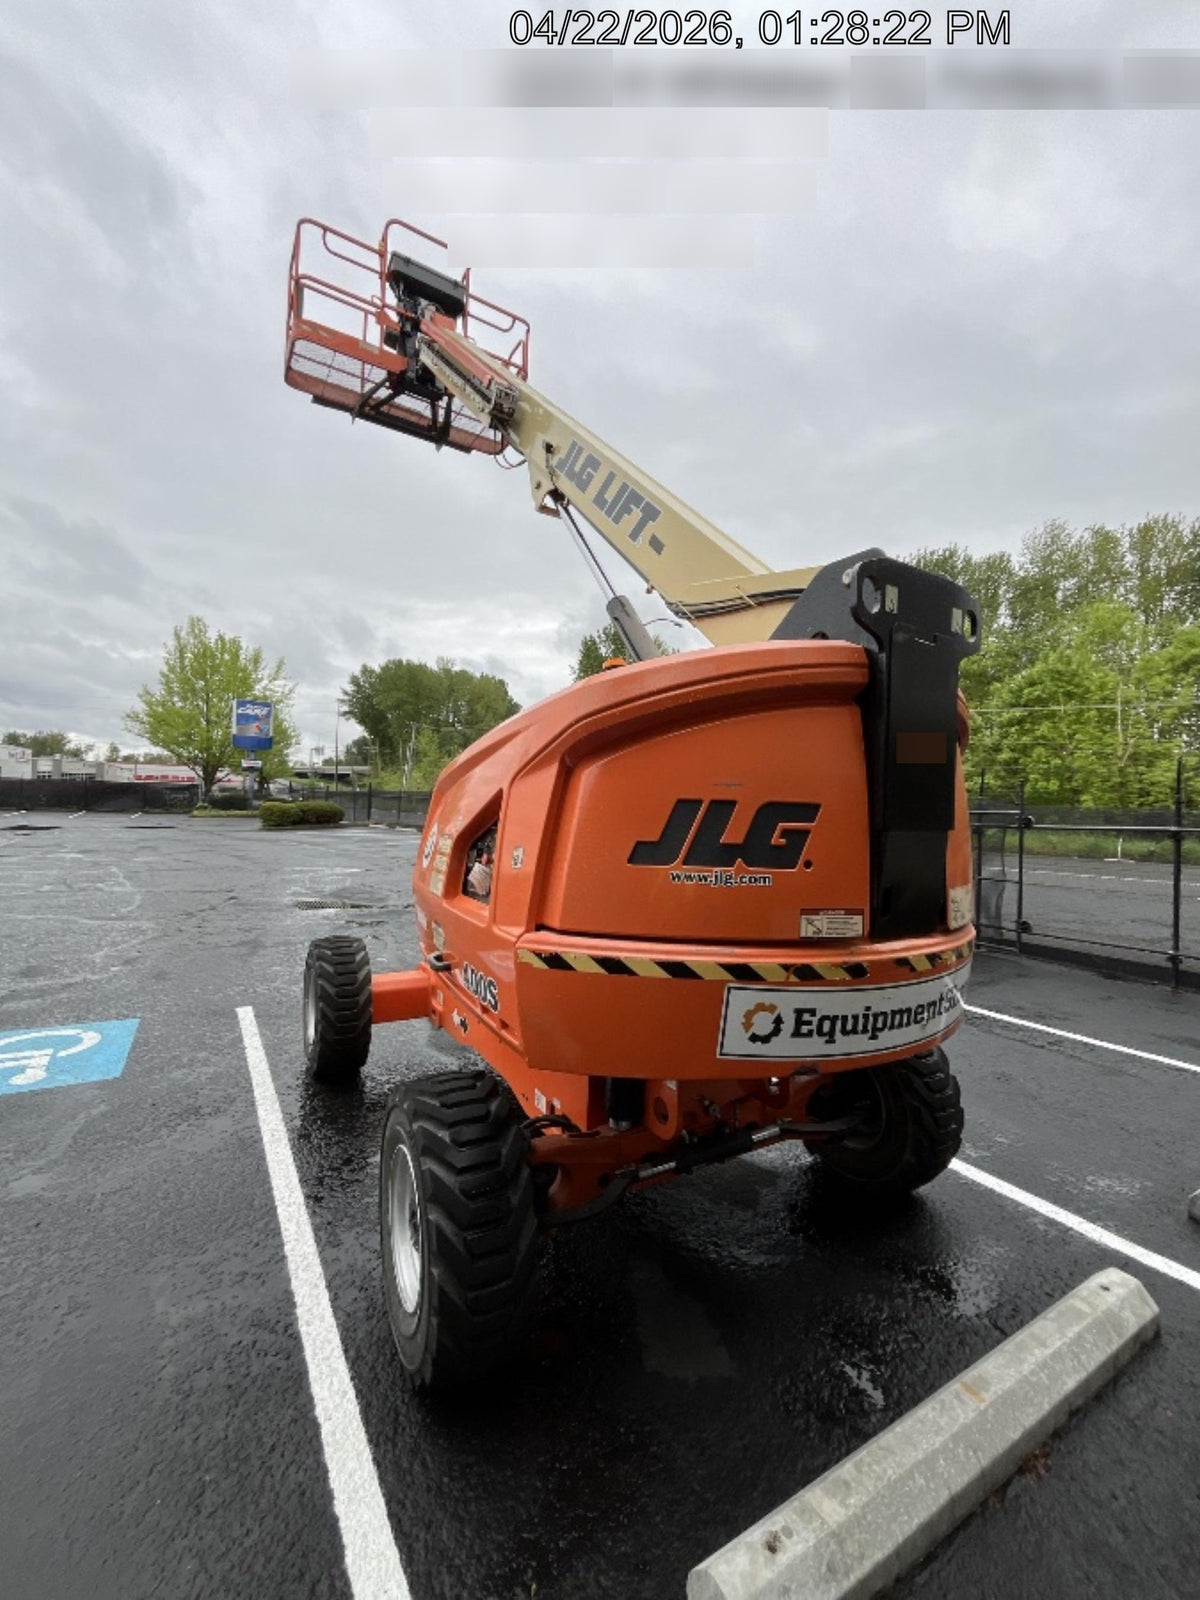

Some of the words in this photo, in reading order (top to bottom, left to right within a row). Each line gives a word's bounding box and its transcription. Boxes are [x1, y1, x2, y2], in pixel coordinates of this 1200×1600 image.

[554, 439, 602, 494] JLG
[591, 470, 662, 544] LIFT
[669, 870, 773, 887] www.jlg.com
